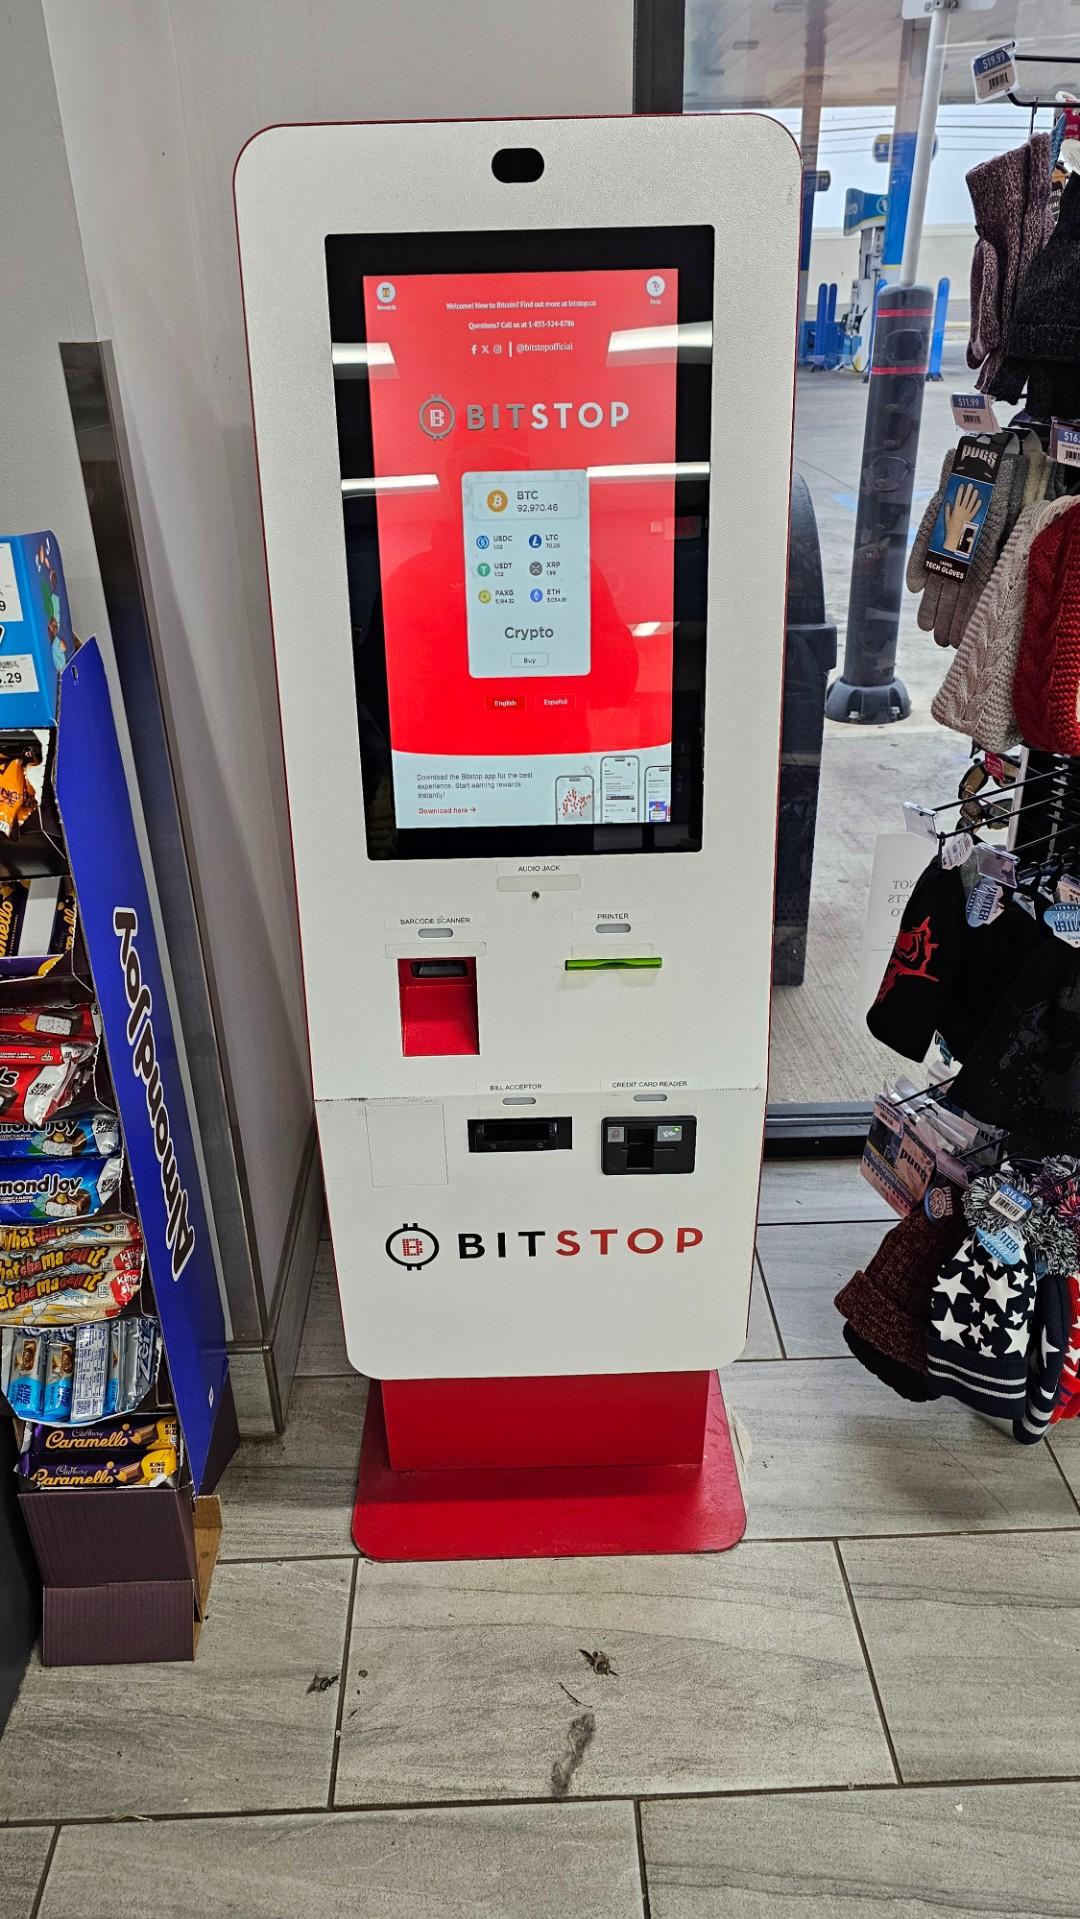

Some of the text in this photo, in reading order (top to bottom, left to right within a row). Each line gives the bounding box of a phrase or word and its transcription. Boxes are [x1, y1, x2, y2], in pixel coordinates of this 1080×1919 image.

[446, 302, 474, 310] Welcome!
[496, 301, 519, 309] Bitcoin?
[520, 300, 533, 308] Find
[468, 321, 499, 330] Questions?
[500, 321, 512, 329] Call
[516, 342, 573, 353] @bitstopofficial
[957, 398, 980, 407] $11.99
[465, 401, 630, 430] BITSTOP
[1063, 431, 1080, 443] $16.
[961, 444, 999, 466] PUGS
[516, 490, 539, 501] BTC
[516, 503, 559, 513] 92,970.46
[493, 535, 513, 543] USDC
[925, 560, 965, 580] TECH GLOVES
[504, 626, 554, 641] Crypto
[523, 657, 536, 665] Buy
[543, 698, 568, 706] Español
[461, 773, 482, 781] Bitstop
[400, 916, 471, 925] BARCODE SCANNER
[597, 912, 629, 920] PRINTER
[504, 1083, 542, 1091] ACCEPTOR
[112, 906, 196, 1282] Almond Joy
[0, 1119, 80, 1136] mond Joy
[0, 1174, 50, 1194] mond
[49, 1174, 83, 1198] Joy
[457, 1227, 704, 1260] BITSTOP
[0, 1245, 109, 1281] hatchamacallit
[0, 1271, 105, 1310] atchamacallit
[23, 1383, 32, 1405] KING
[71, 1428, 104, 1438] Cadbury
[45, 1430, 129, 1449] Caramello
[55, 1464, 88, 1475] Cadbury
[31, 1469, 114, 1486] Caramello
